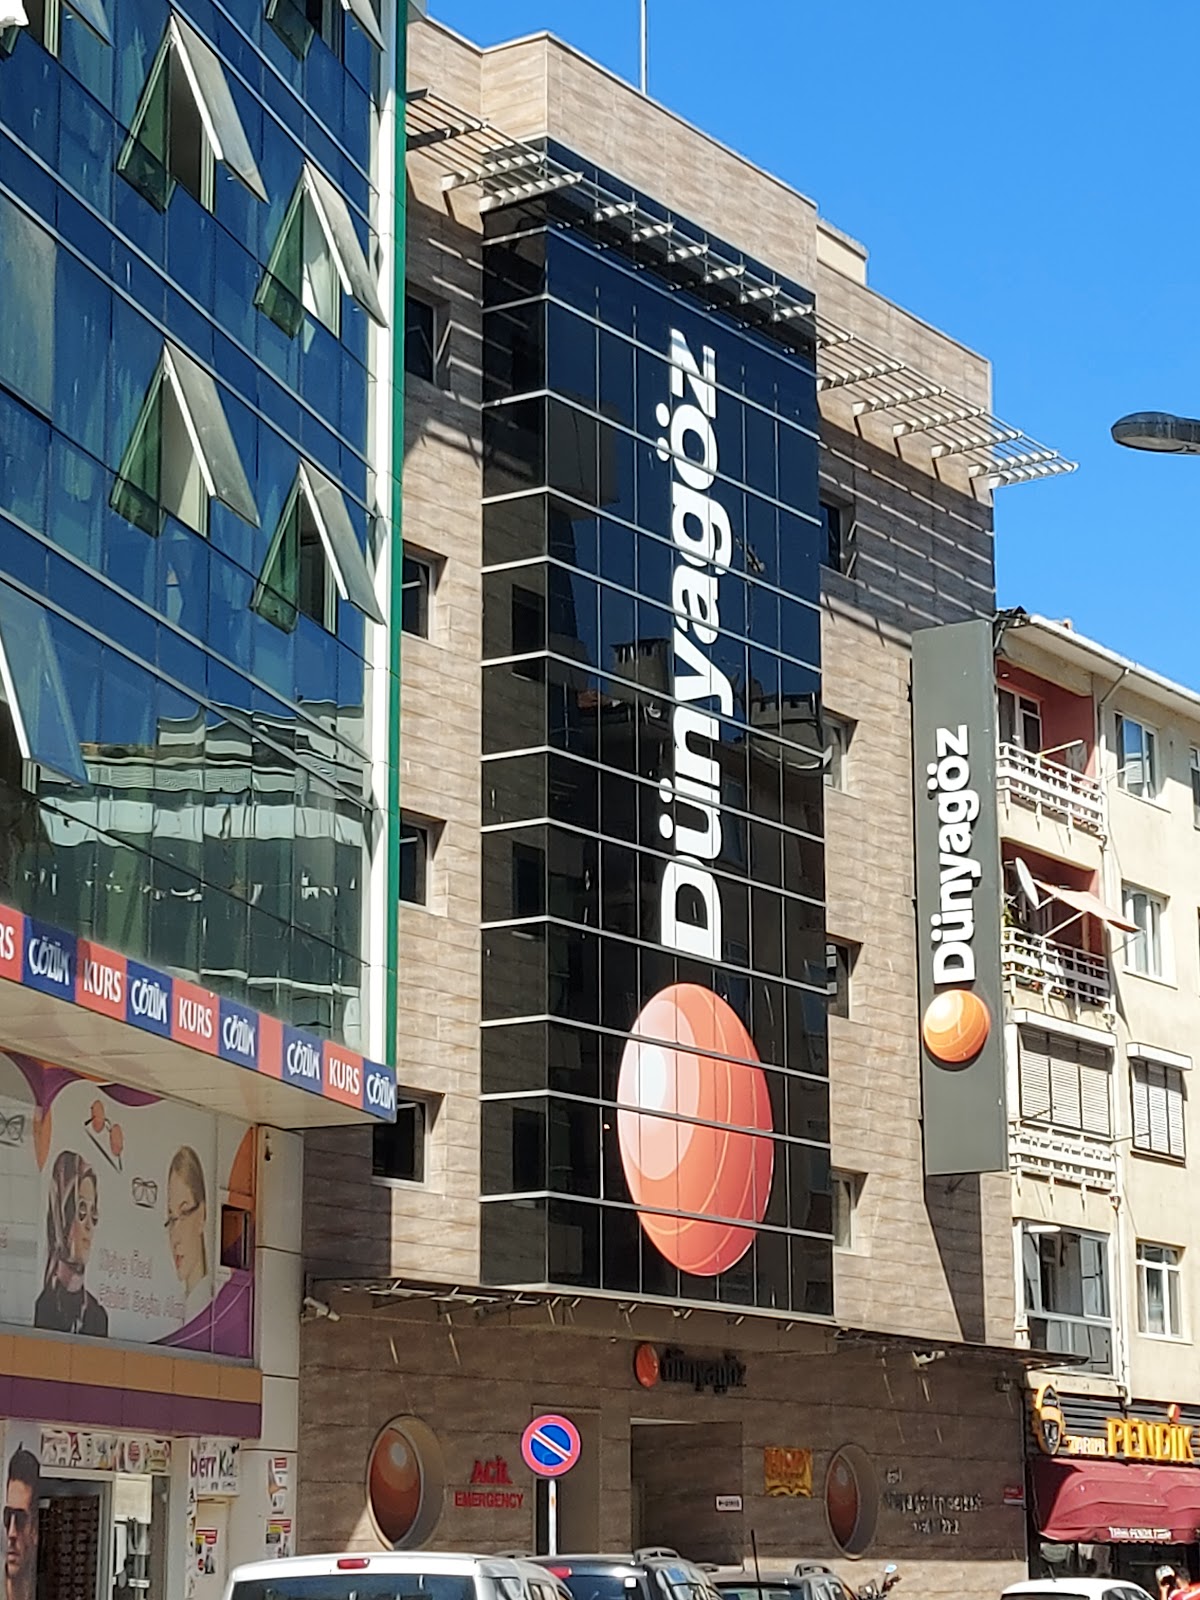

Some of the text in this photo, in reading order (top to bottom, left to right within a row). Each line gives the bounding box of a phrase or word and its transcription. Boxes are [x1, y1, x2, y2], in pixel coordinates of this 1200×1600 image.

[660, 328, 733, 962] Dünyagöz
[926, 724, 982, 985] Dünyagöz
[83, 959, 122, 1004] KURS
[178, 997, 213, 1039] KURS
[328, 1057, 360, 1096] KURS
[454, 1491, 524, 1509] EMERGENCY
[470, 1455, 513, 1484] ACİL
